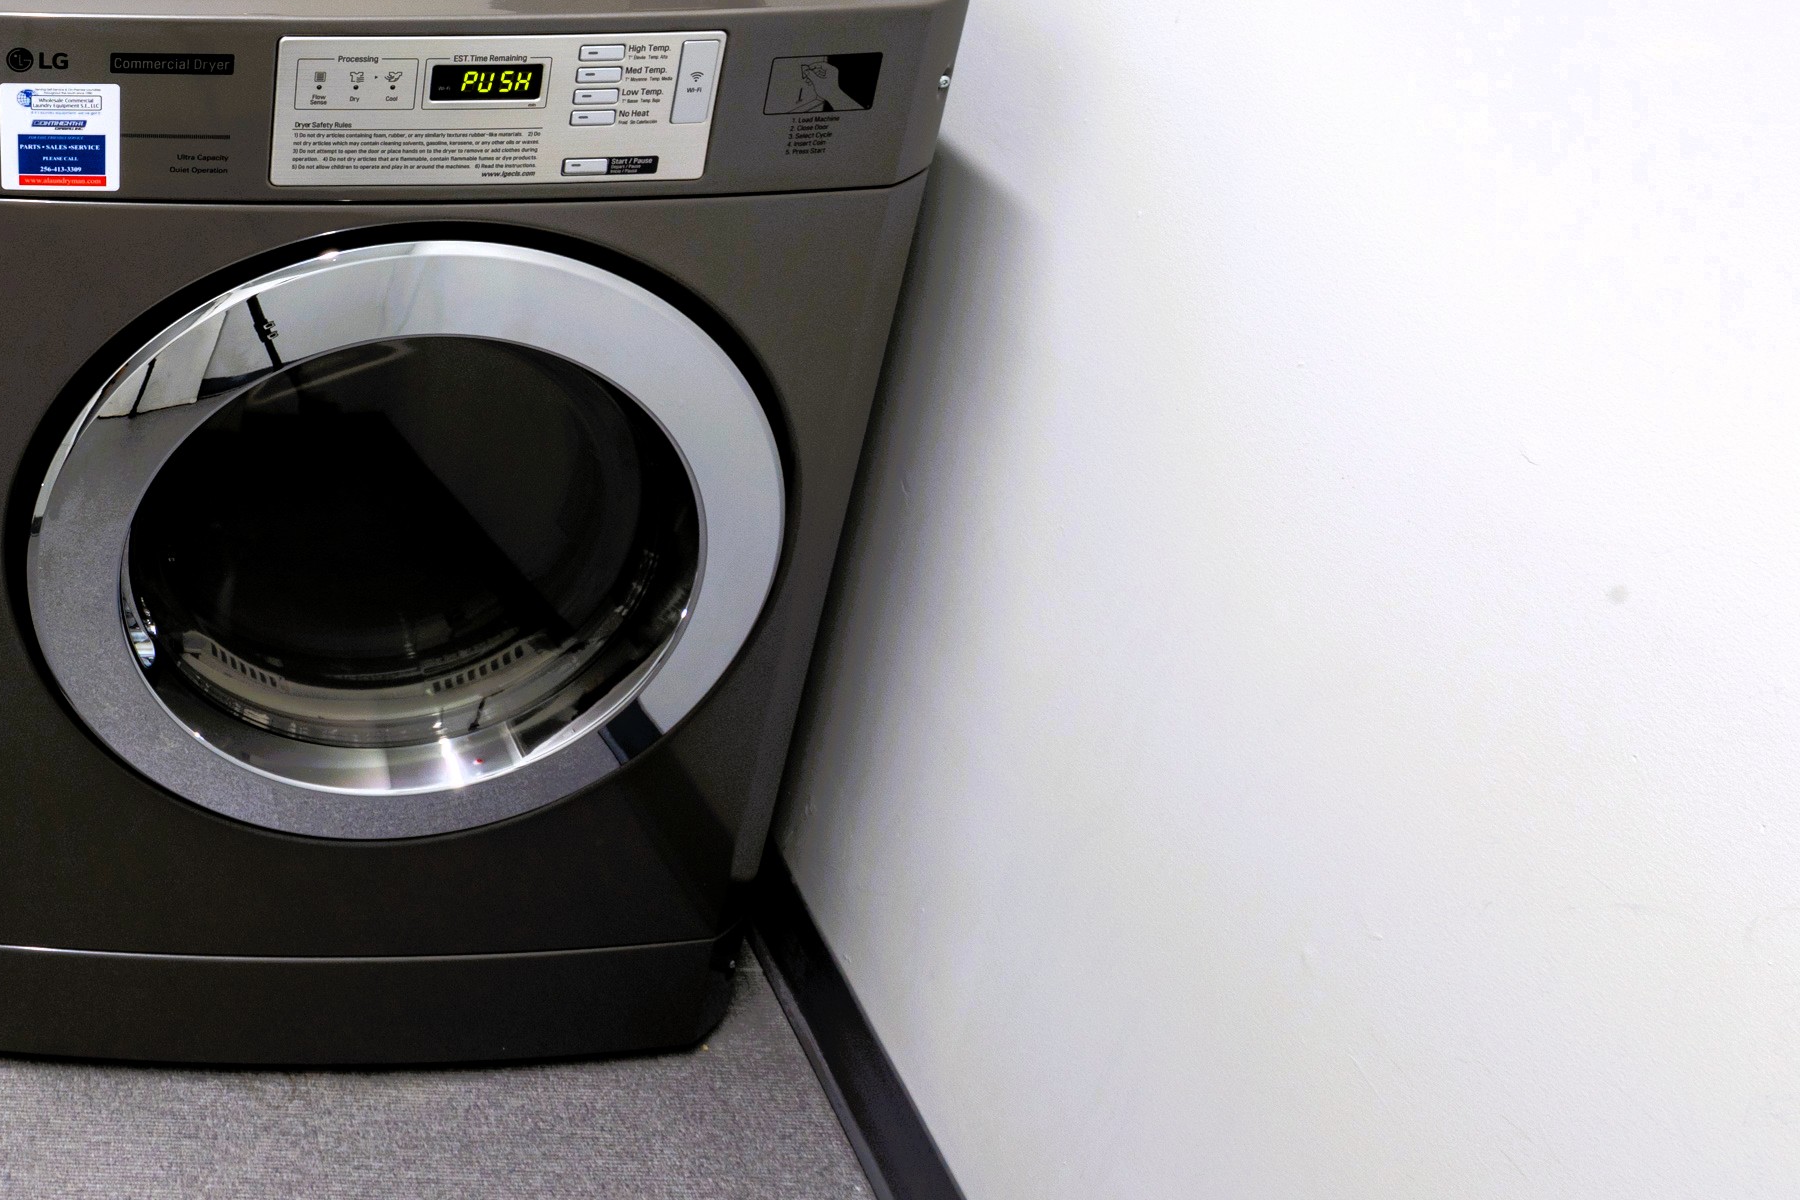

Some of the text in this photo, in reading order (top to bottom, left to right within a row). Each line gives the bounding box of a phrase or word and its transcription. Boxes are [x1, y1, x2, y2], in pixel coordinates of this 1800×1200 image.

[628, 45, 646, 53] High
[39, 52, 68, 69] LG
[114, 58, 229, 70] Commercial Dryer
[462, 71, 532, 92] PUSH
[641, 88, 663, 96] Temp.
